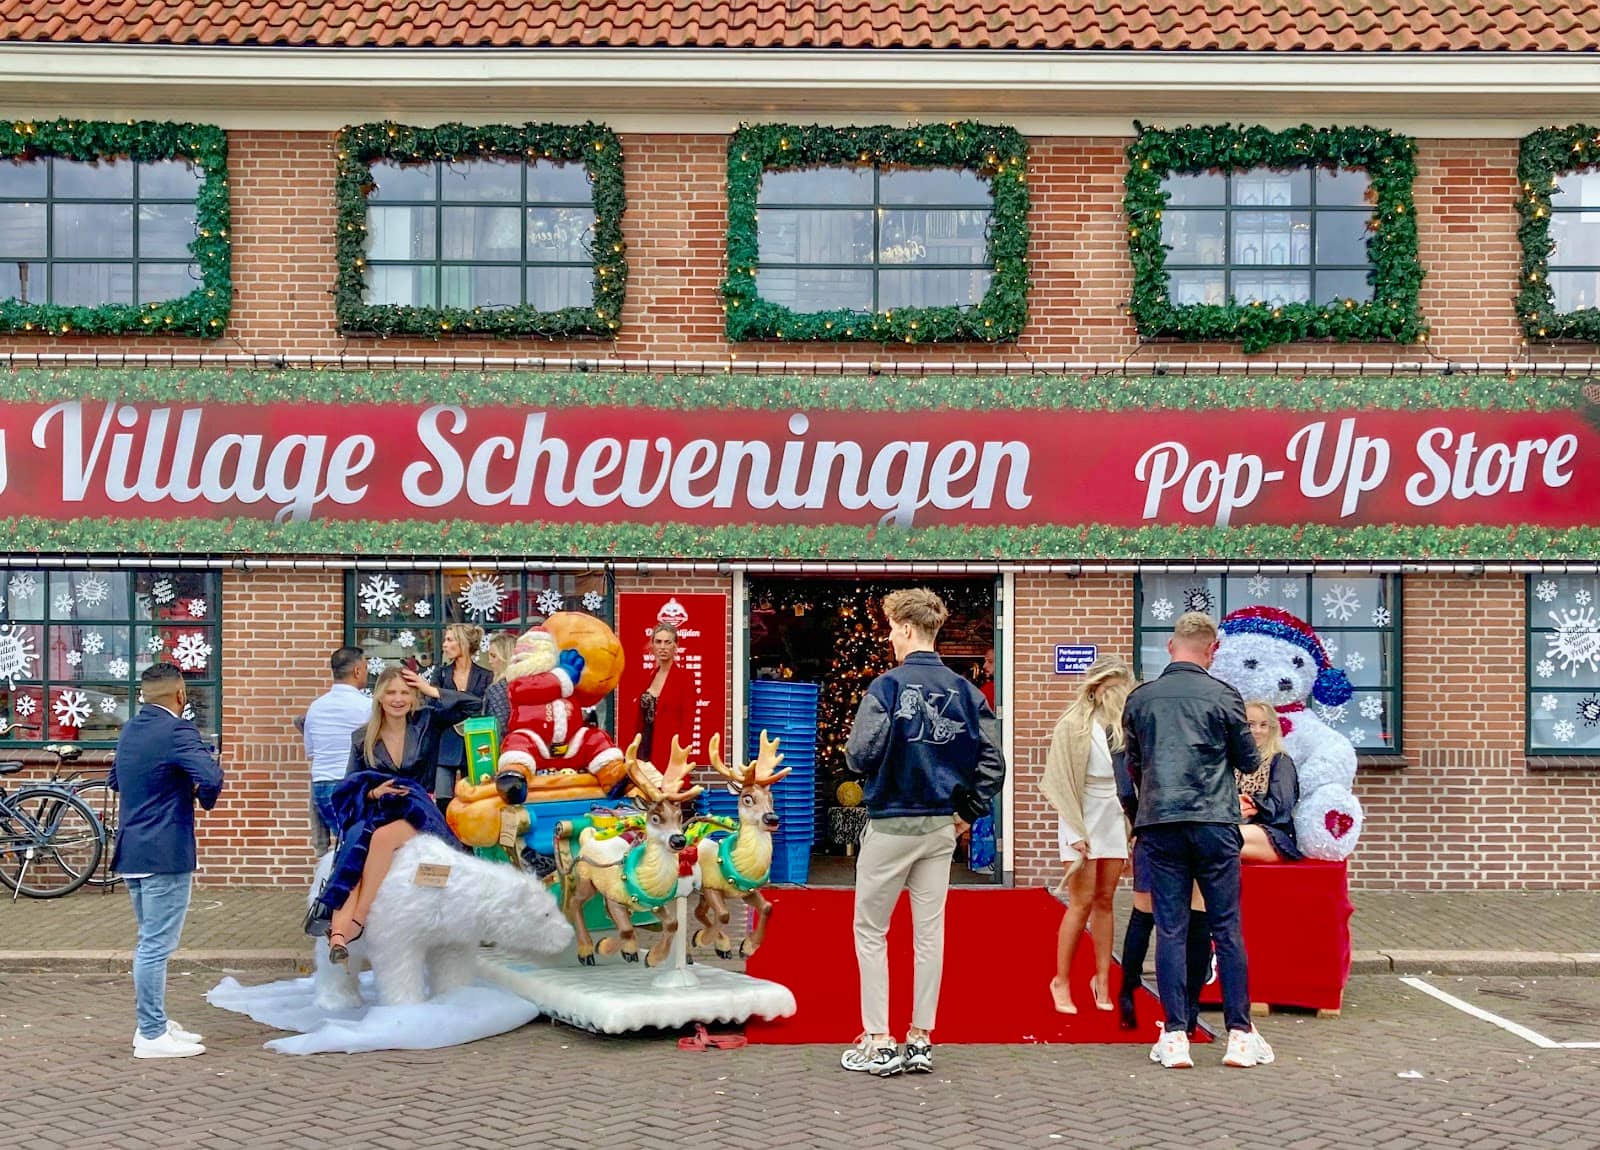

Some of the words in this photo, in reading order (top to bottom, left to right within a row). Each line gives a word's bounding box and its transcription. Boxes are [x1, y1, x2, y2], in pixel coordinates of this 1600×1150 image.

[31, 399, 376, 524] Village
[401, 404, 1033, 528] Scheveningen
[1134, 417, 1390, 528] Pop-Up
[1405, 427, 1578, 507] Store
